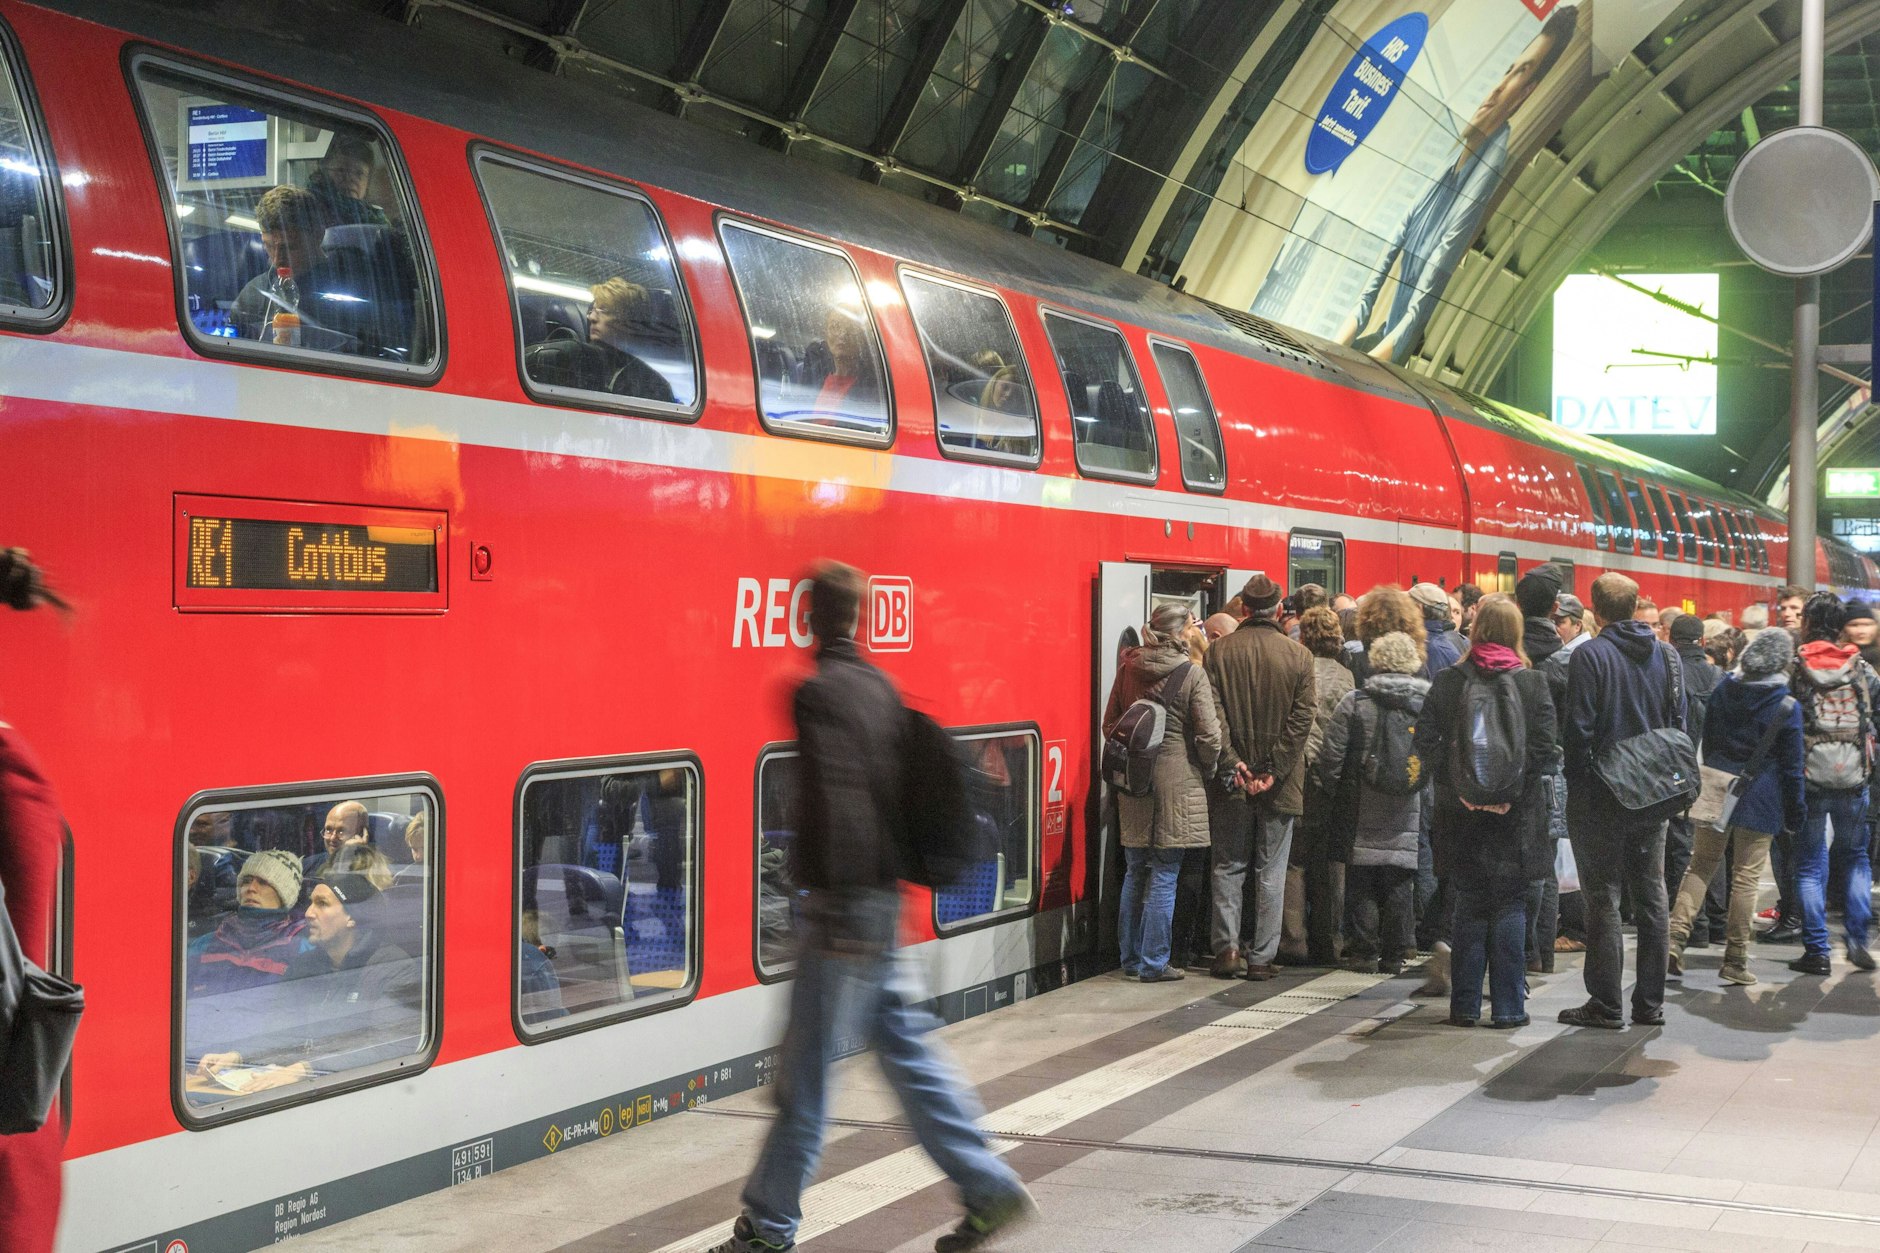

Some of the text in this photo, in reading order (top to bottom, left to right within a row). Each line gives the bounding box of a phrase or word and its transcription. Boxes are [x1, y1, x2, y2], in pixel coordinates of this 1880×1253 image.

[1380, 36, 1409, 63] HRS
[1353, 56, 1394, 96] Business
[1342, 88, 1372, 120] Tarif.
[1556, 395, 1712, 430] DATEV
[192, 518, 386, 586] RE1 Cottbus
[732, 577, 859, 649] REG
[872, 586, 908, 641] DB
[1048, 746, 1062, 803] 2
[563, 1119, 599, 1141] KE-PR-A-Mg
[621, 1107, 632, 1124] ep
[455, 1144, 490, 1167] 49t 59t
[457, 1168, 472, 1184] 134
[275, 1191, 319, 1217] DB Regio AG
[275, 1206, 326, 1234] Region Nordost
